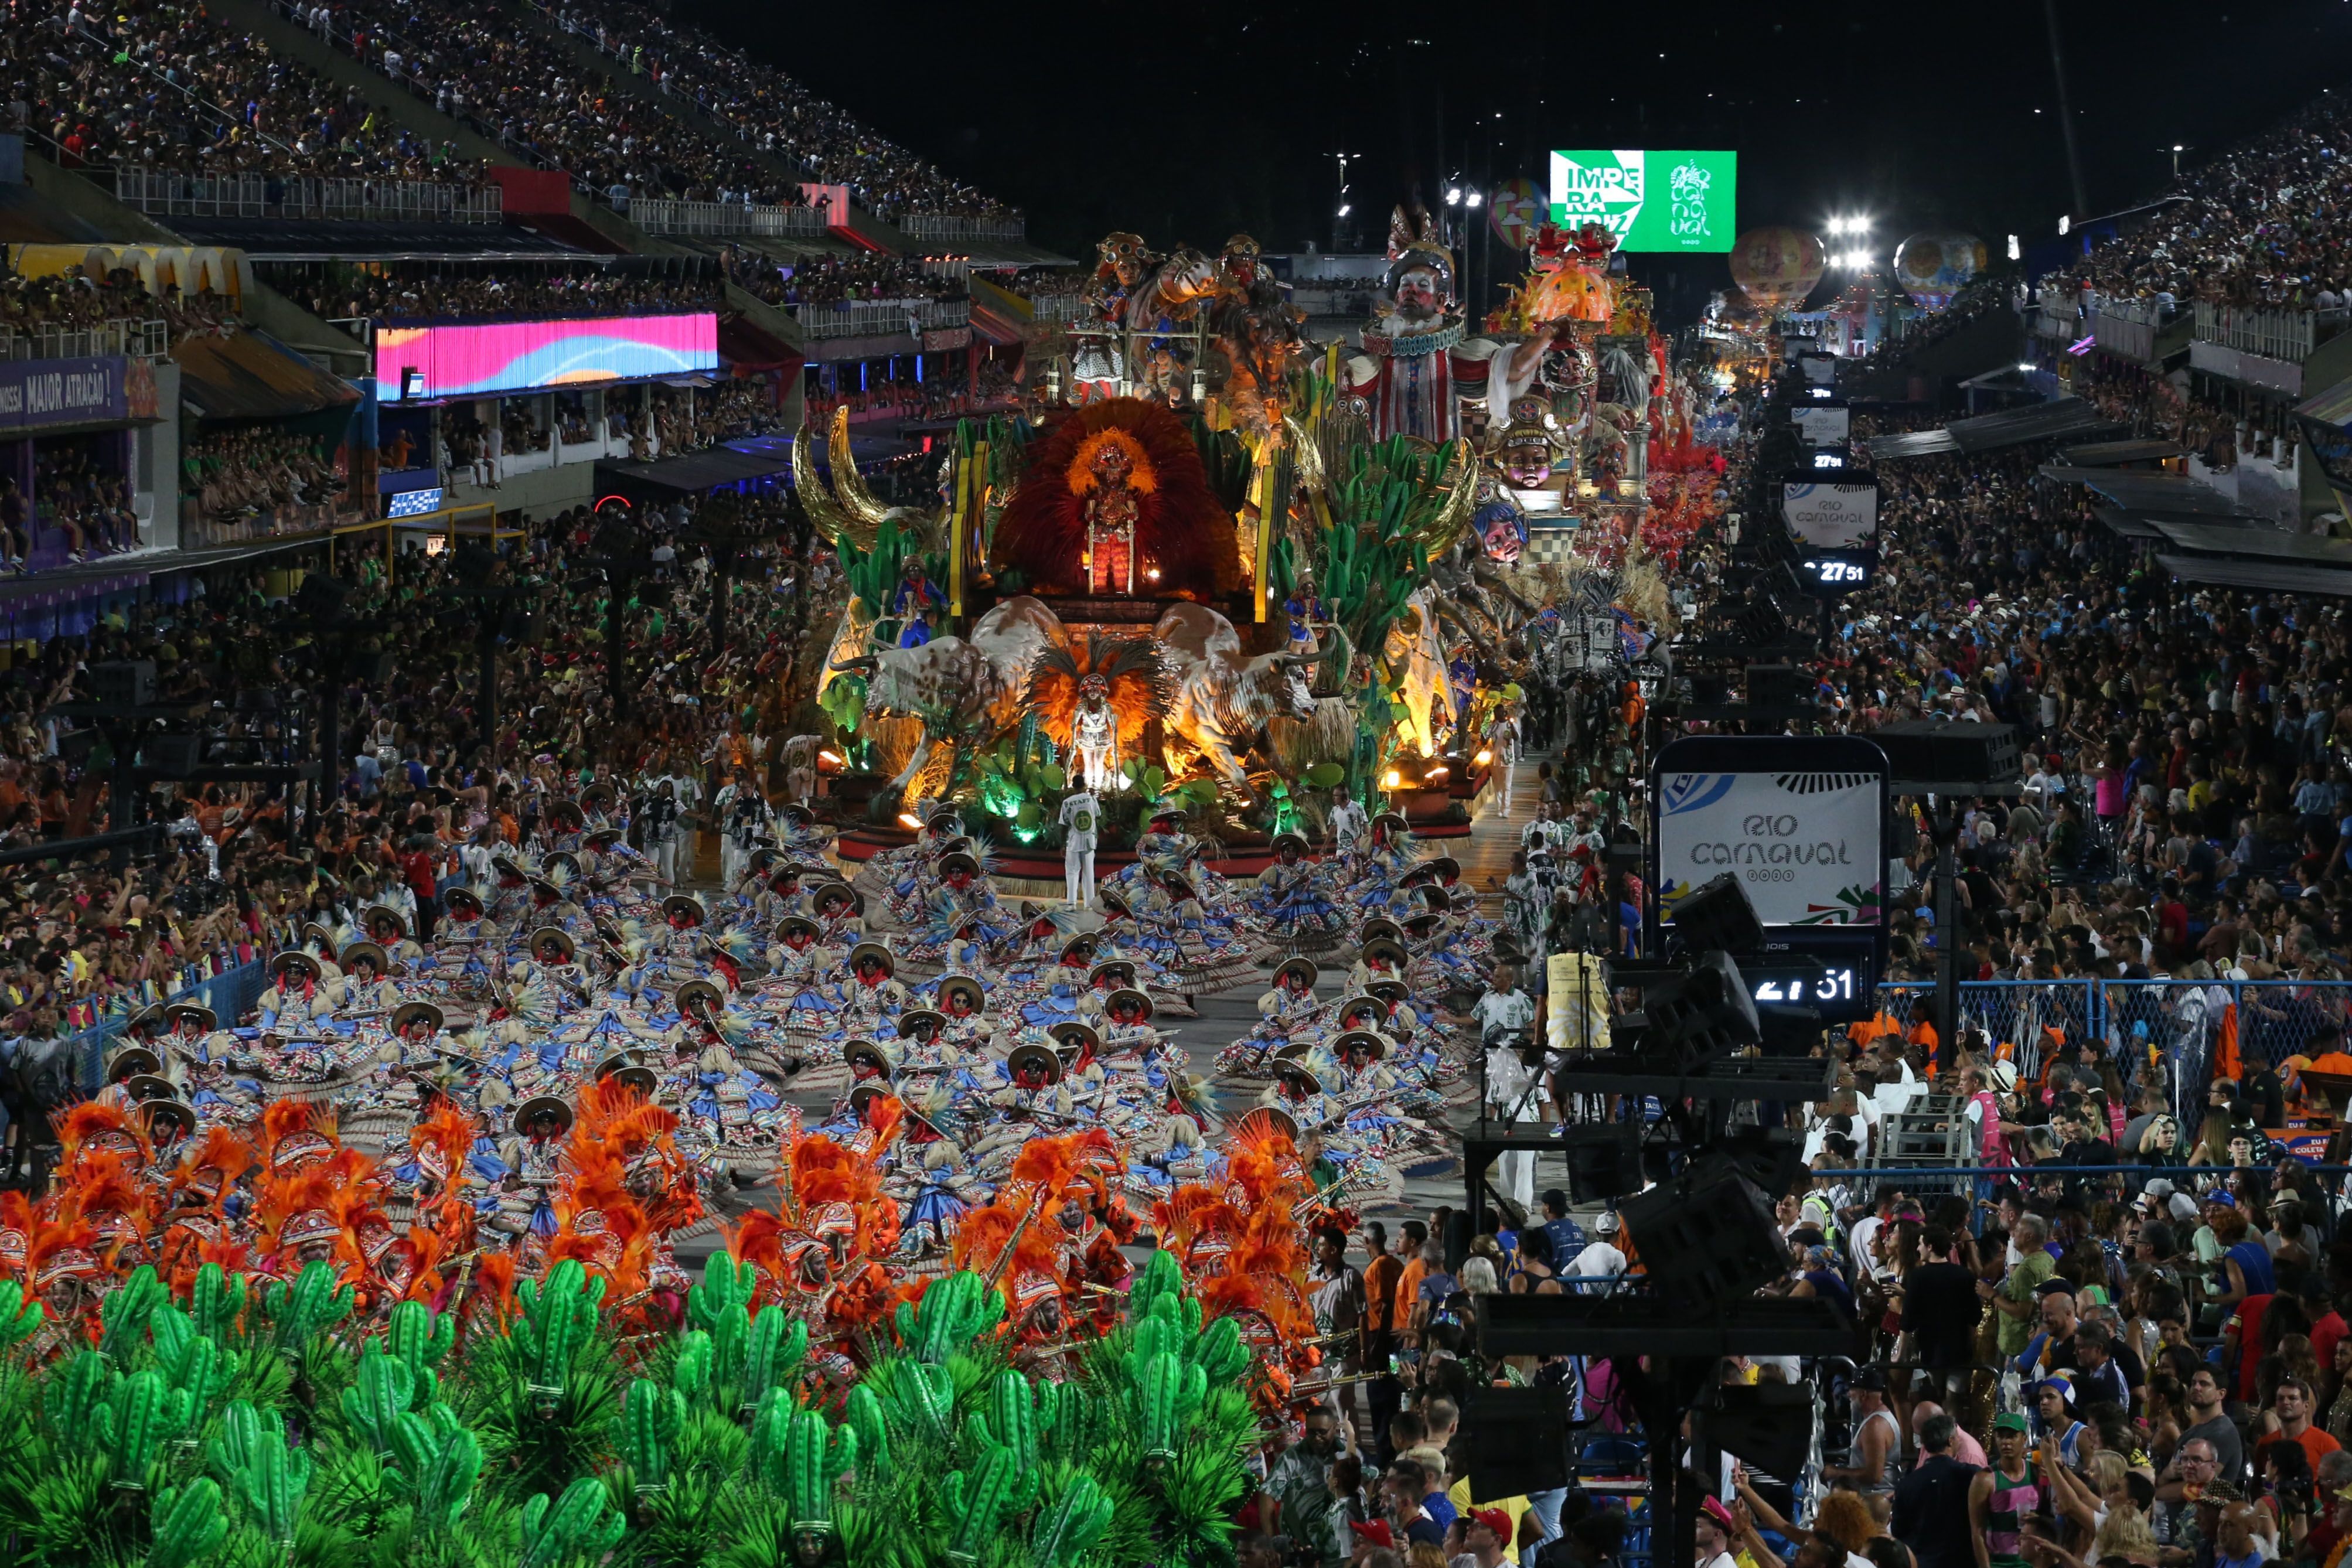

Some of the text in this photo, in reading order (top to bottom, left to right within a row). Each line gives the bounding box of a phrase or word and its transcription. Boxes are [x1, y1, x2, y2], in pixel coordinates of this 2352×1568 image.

[1567, 168, 1639, 189] IMPE
[1566, 192, 1607, 212] RA
[26, 373, 63, 414] MAIOR
[1821, 563, 1846, 581] 27
[1846, 566, 1863, 581] 51
[1069, 798, 1090, 807] STAFF
[1748, 871, 1793, 881] 2023
